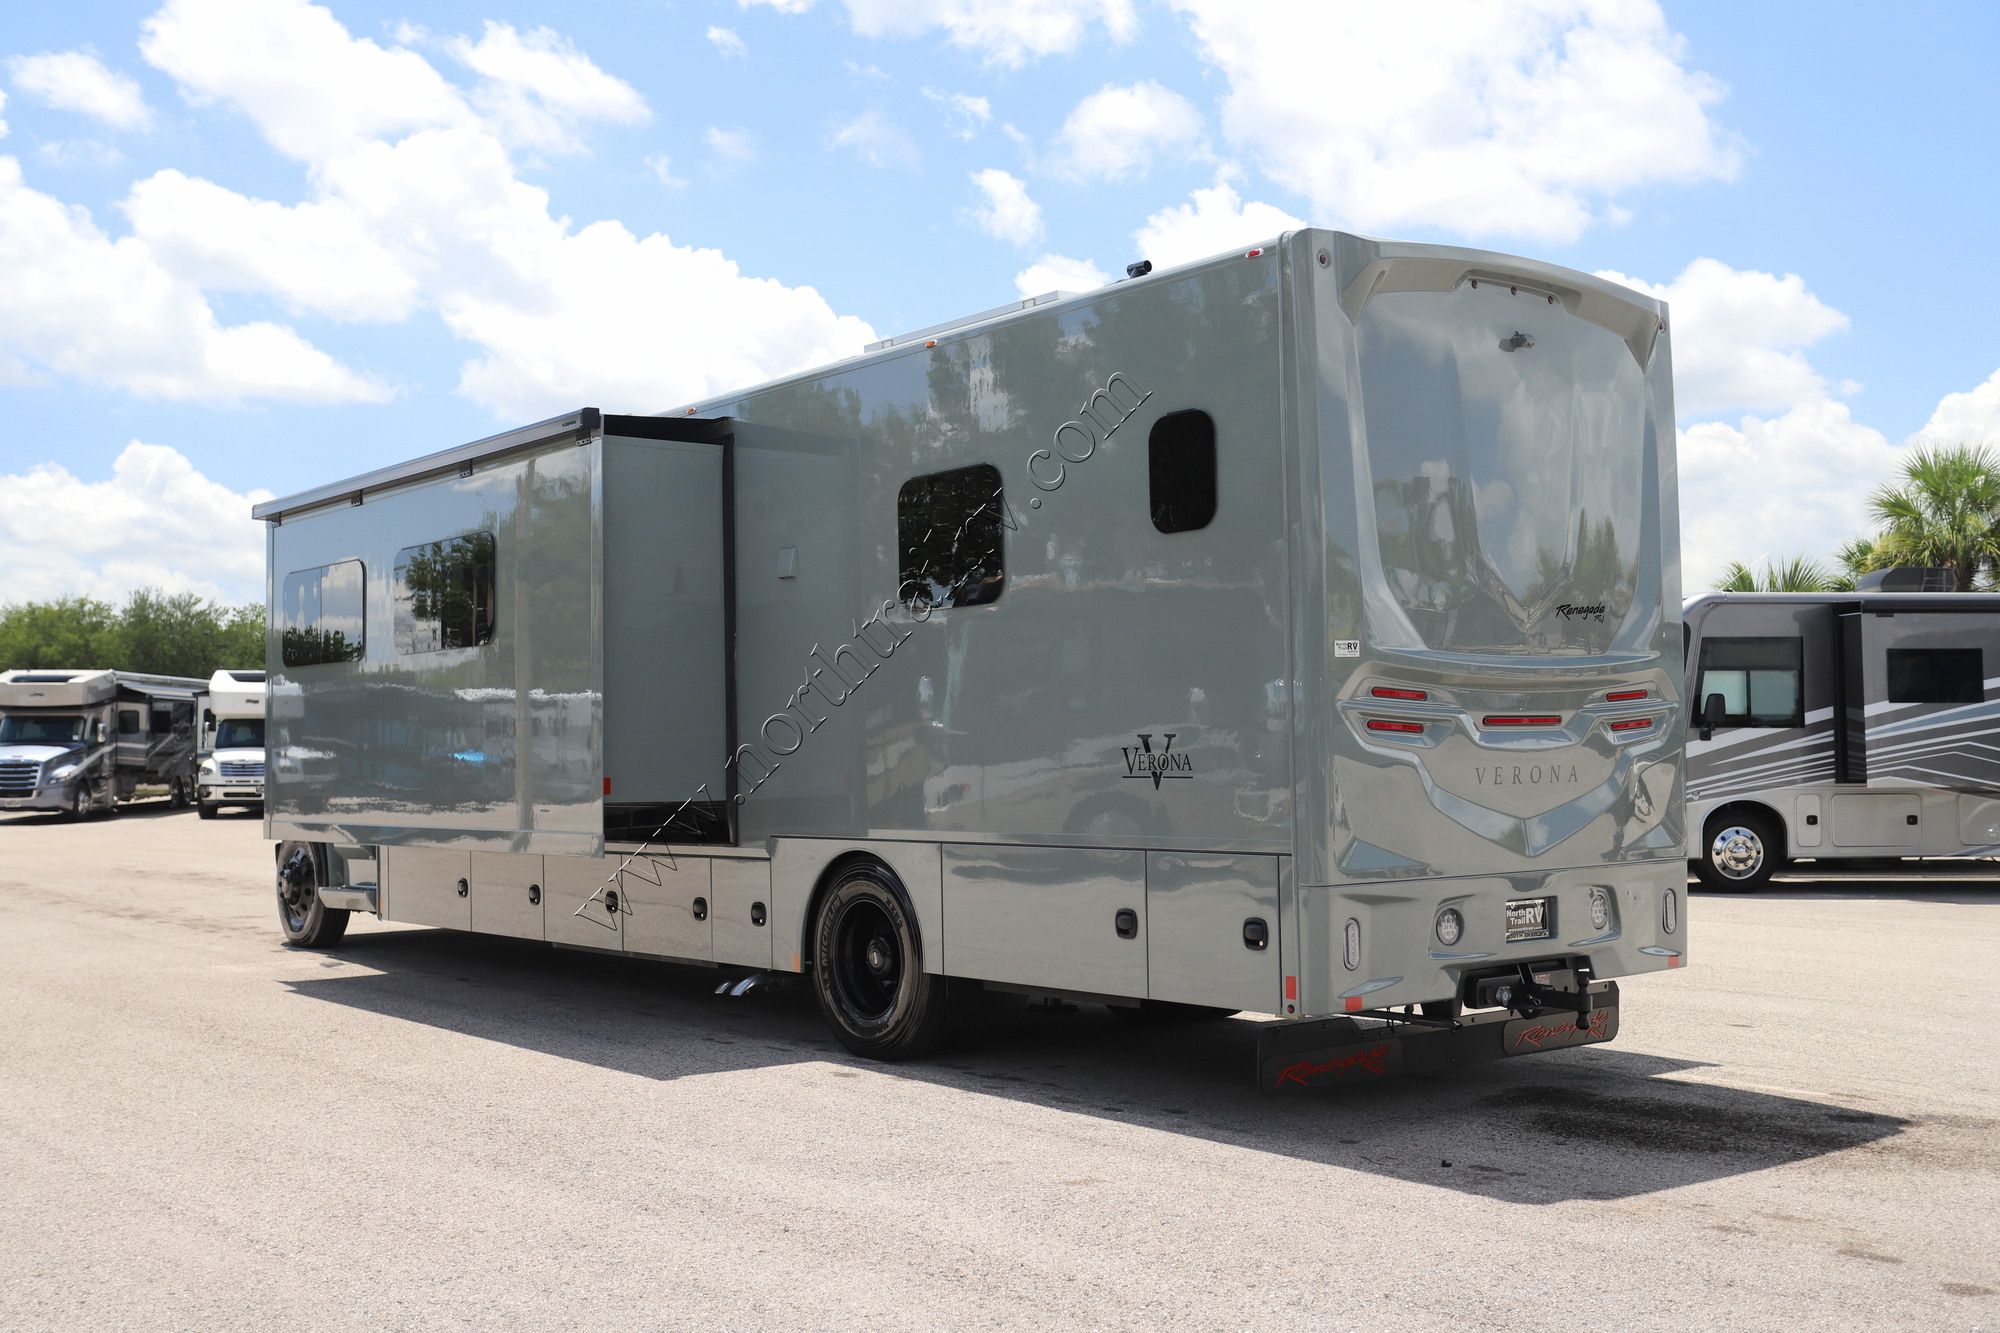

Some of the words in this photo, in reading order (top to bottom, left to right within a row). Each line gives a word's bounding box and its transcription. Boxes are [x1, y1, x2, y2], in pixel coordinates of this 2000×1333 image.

[1555, 601, 1606, 621] Renegade
[1347, 642, 1358, 650] RV
[1121, 747, 1193, 775] VERONA
[1475, 764, 1579, 785] VERONA
[1506, 908, 1526, 918] North
[1525, 907, 1544, 924] RV
[1510, 916, 1526, 926] Trail
